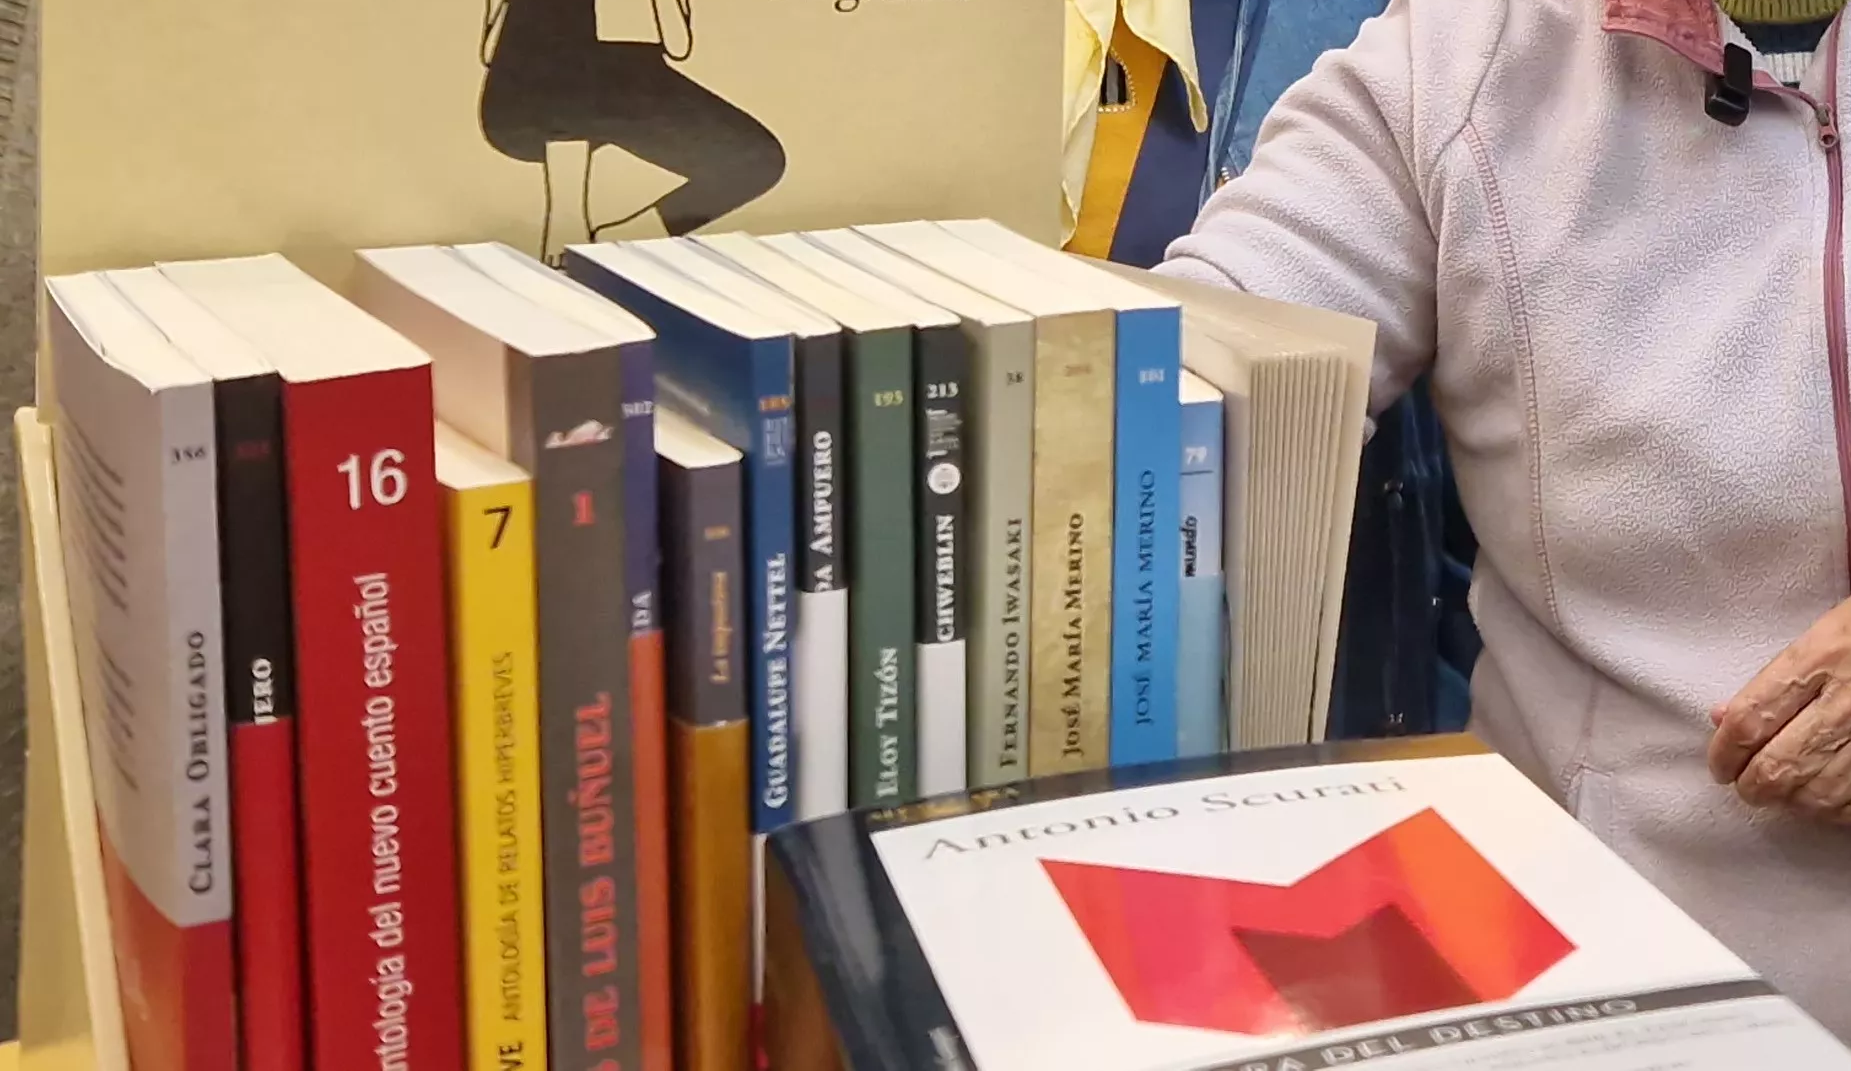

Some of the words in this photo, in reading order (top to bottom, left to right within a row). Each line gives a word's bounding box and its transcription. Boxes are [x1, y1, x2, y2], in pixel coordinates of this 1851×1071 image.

[337, 448, 409, 511] 16
[572, 491, 595, 527] 1
[810, 430, 834, 557] AMPUERO
[1137, 469, 1158, 574] MERINO
[483, 505, 513, 550] 7
[1002, 517, 1024, 627] IWASAKI
[1063, 512, 1085, 607] MERINO
[764, 552, 788, 654] NETTEL
[933, 514, 956, 643] CHWEBLIN
[1137, 578, 1155, 664] MARÍA
[353, 571, 399, 689] español
[1061, 610, 1084, 698] MARÍA
[186, 630, 210, 782] OBLIGADO
[872, 647, 899, 730] TIZÓN
[998, 632, 1021, 770] FERNANDO
[1060, 700, 1084, 760] JOSÉ
[1133, 672, 1154, 729] JOSÉ
[361, 696, 398, 798] cuento
[763, 658, 789, 810] GUADALUPE
[875, 734, 900, 800] ELOY
[567, 691, 615, 867] BUÑUEL
[924, 800, 1180, 861] Antonio
[1203, 775, 1409, 815] Scurati
[189, 796, 213, 896] CLARA
[370, 805, 402, 895] nuevo
[496, 788, 519, 873] RELATOS
[368, 901, 404, 949] del
[499, 881, 520, 906] DE
[578, 876, 619, 977] LUIS
[368, 954, 414, 1071] ntología
[499, 1040, 525, 1071] VE
[583, 986, 621, 1051] DE
[1319, 1034, 1412, 1067] DEL
[1428, 996, 1638, 1048] DESTINO
